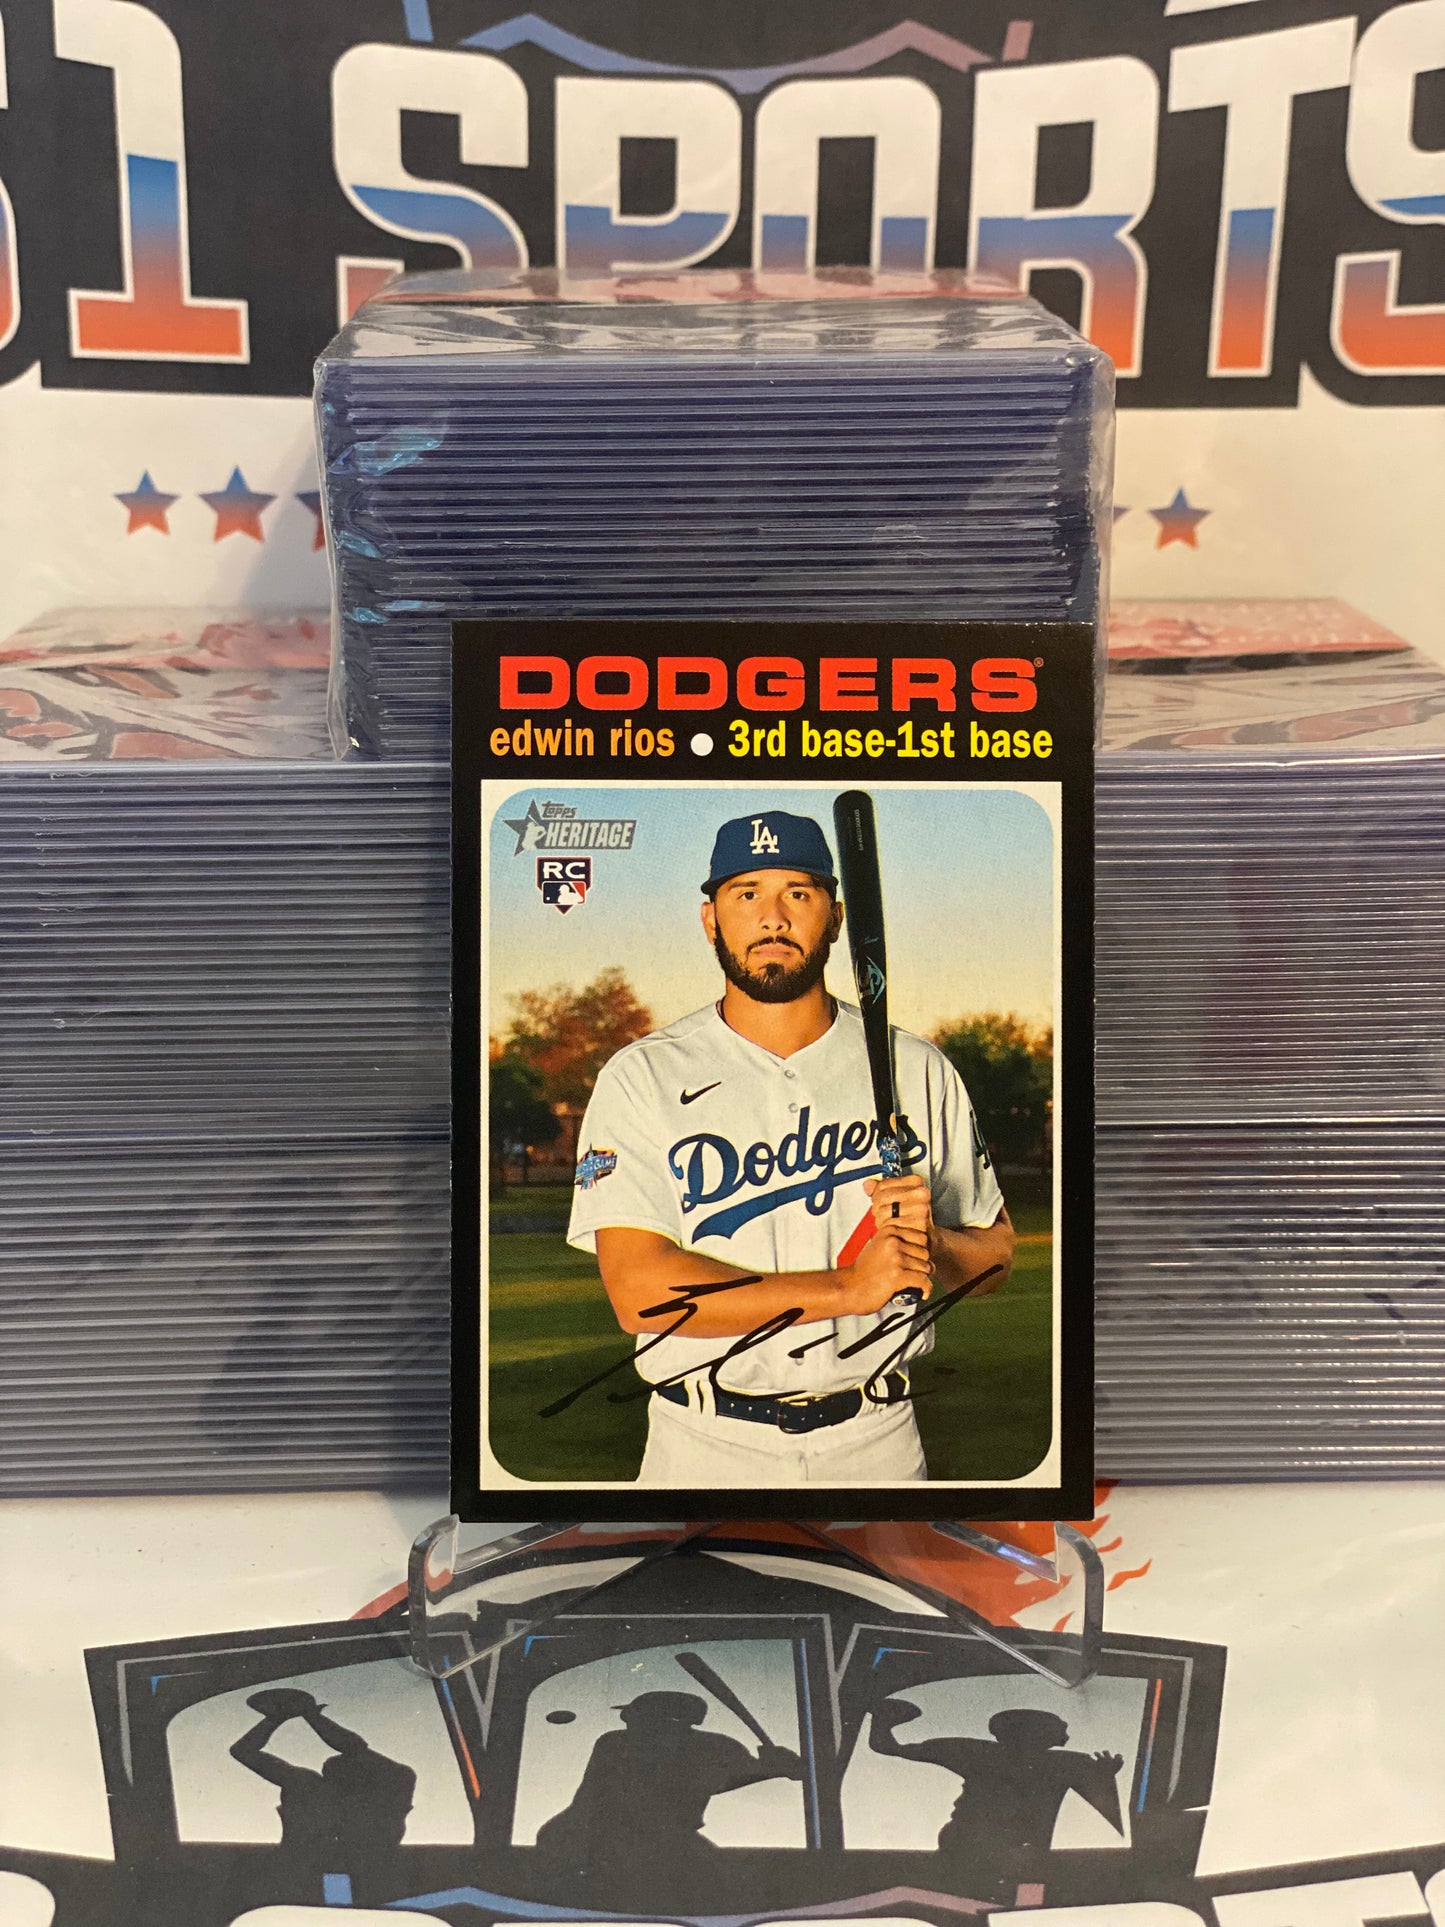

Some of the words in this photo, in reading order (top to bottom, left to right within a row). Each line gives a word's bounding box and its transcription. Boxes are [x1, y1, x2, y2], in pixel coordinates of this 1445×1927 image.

[489, 718, 595, 757] edwin
[610, 718, 676, 757] rios
[728, 720, 786, 757] 3rd
[802, 720, 955, 758] base-1st
[970, 721, 1053, 758] base
[545, 821, 634, 848] HERITAGE
[749, 818, 780, 854] LA
[543, 861, 586, 879] RC
